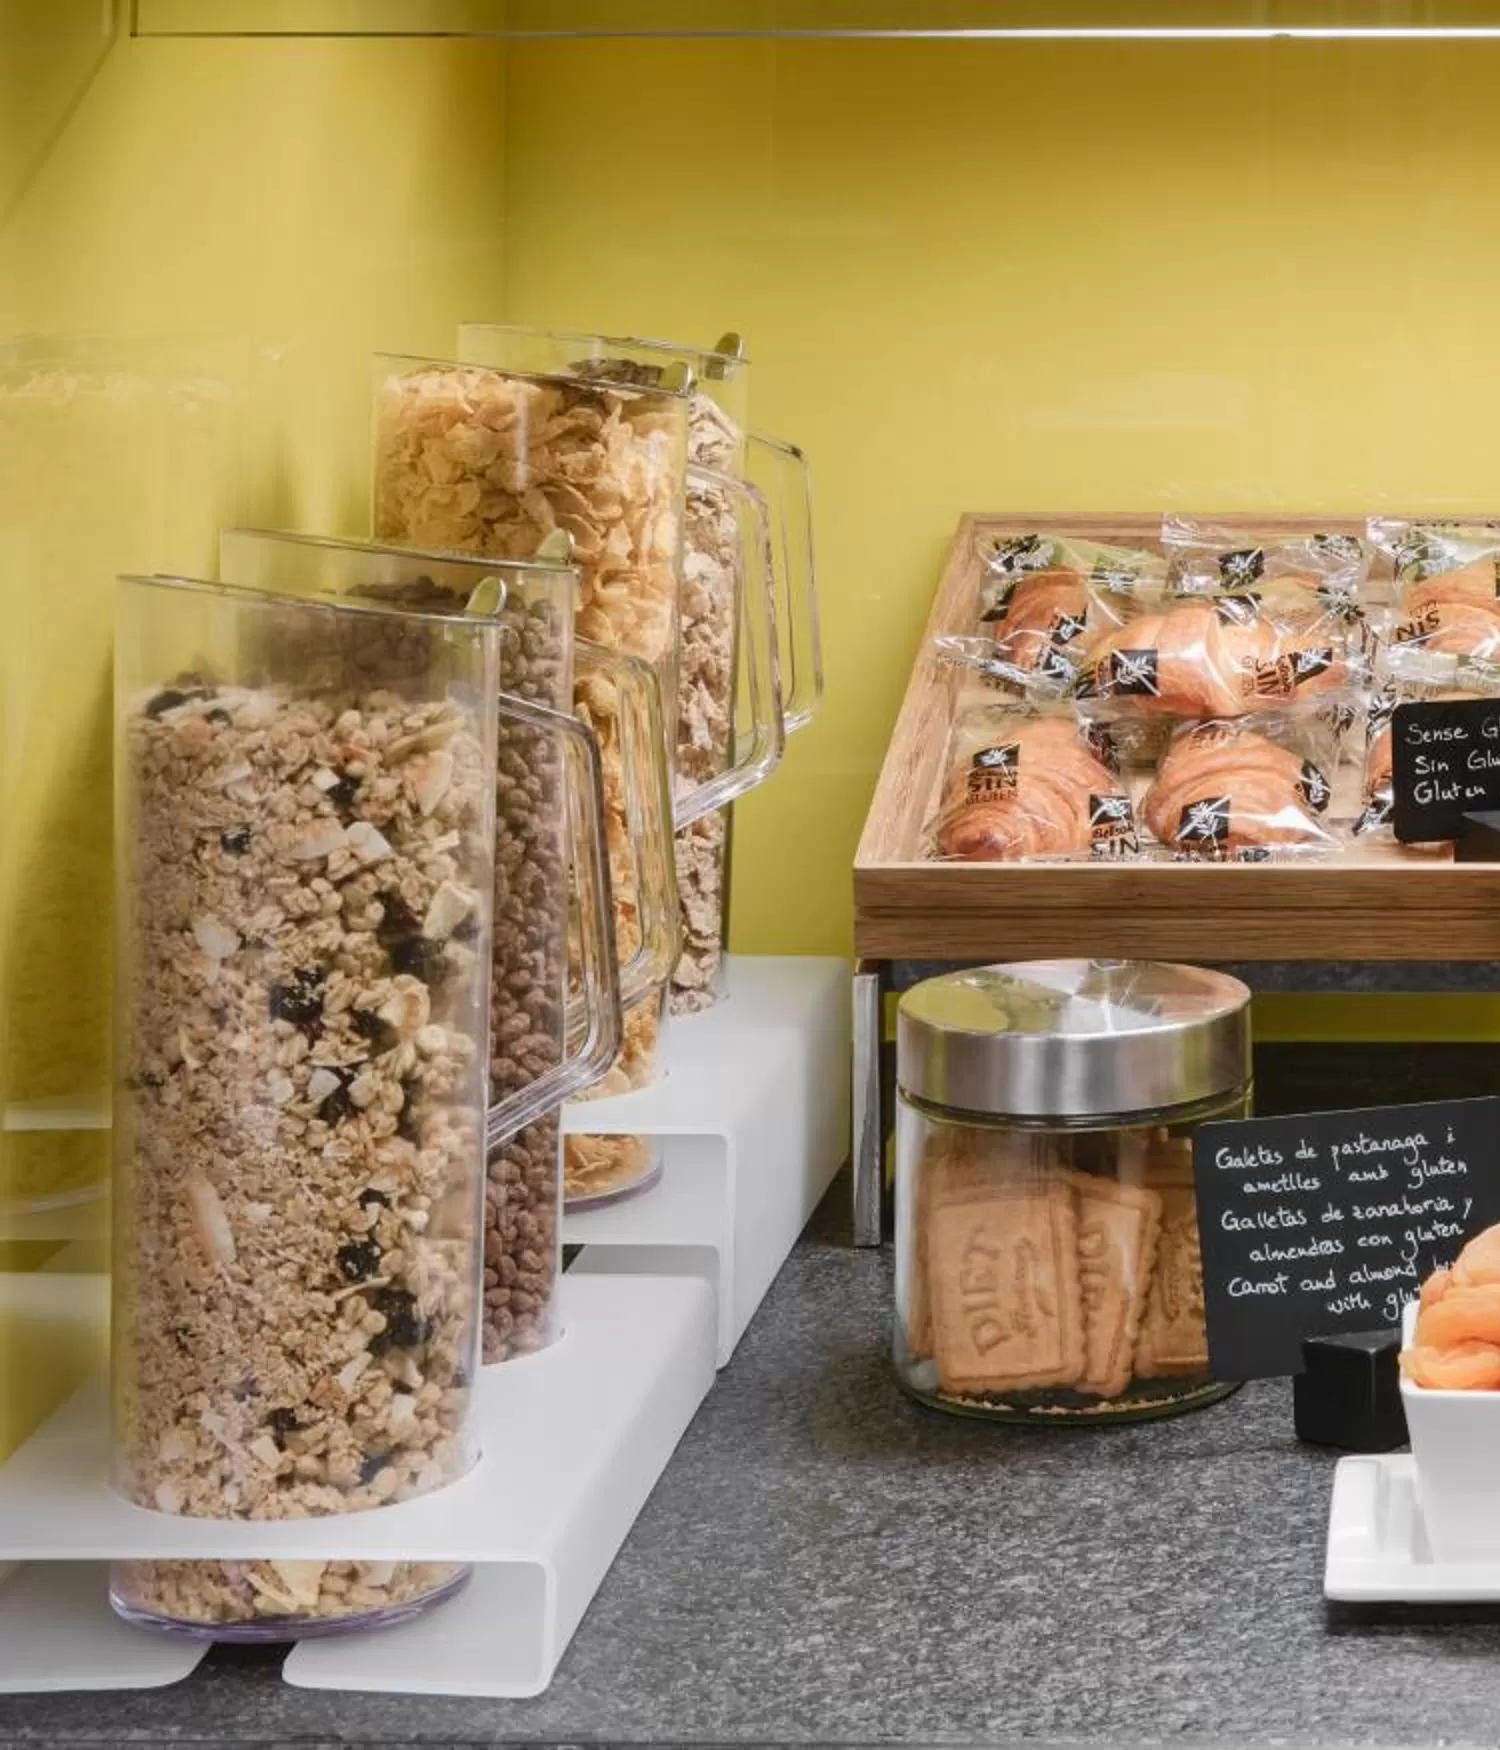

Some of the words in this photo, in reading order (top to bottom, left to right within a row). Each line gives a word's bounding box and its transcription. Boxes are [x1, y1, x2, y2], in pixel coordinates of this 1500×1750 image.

[1408, 723, 1468, 745] Sense
[1415, 756, 1448, 774] Sin
[1414, 781, 1486, 804] Gluten
[1216, 1147, 1283, 1169] Galetes
[1296, 1140, 1318, 1159] de
[1331, 1133, 1429, 1172] pastanaga
[1349, 1163, 1388, 1182] amb
[1408, 1156, 1467, 1189] gluten
[1222, 1209, 1306, 1231] Galletas
[1321, 1203, 1344, 1223] de
[1352, 1196, 1454, 1219] zanahoria
[1463, 1197, 1472, 1219] y
[1250, 1237, 1344, 1262] almendras
[1357, 1235, 1392, 1246] con
[1402, 1221, 1464, 1261] gluten
[1227, 1273, 1289, 1297] Carrot
[1300, 1270, 1335, 1291] and
[1349, 1260, 1416, 1284] almond
[1328, 1293, 1371, 1313] with
[1383, 1284, 1421, 1321] glu
